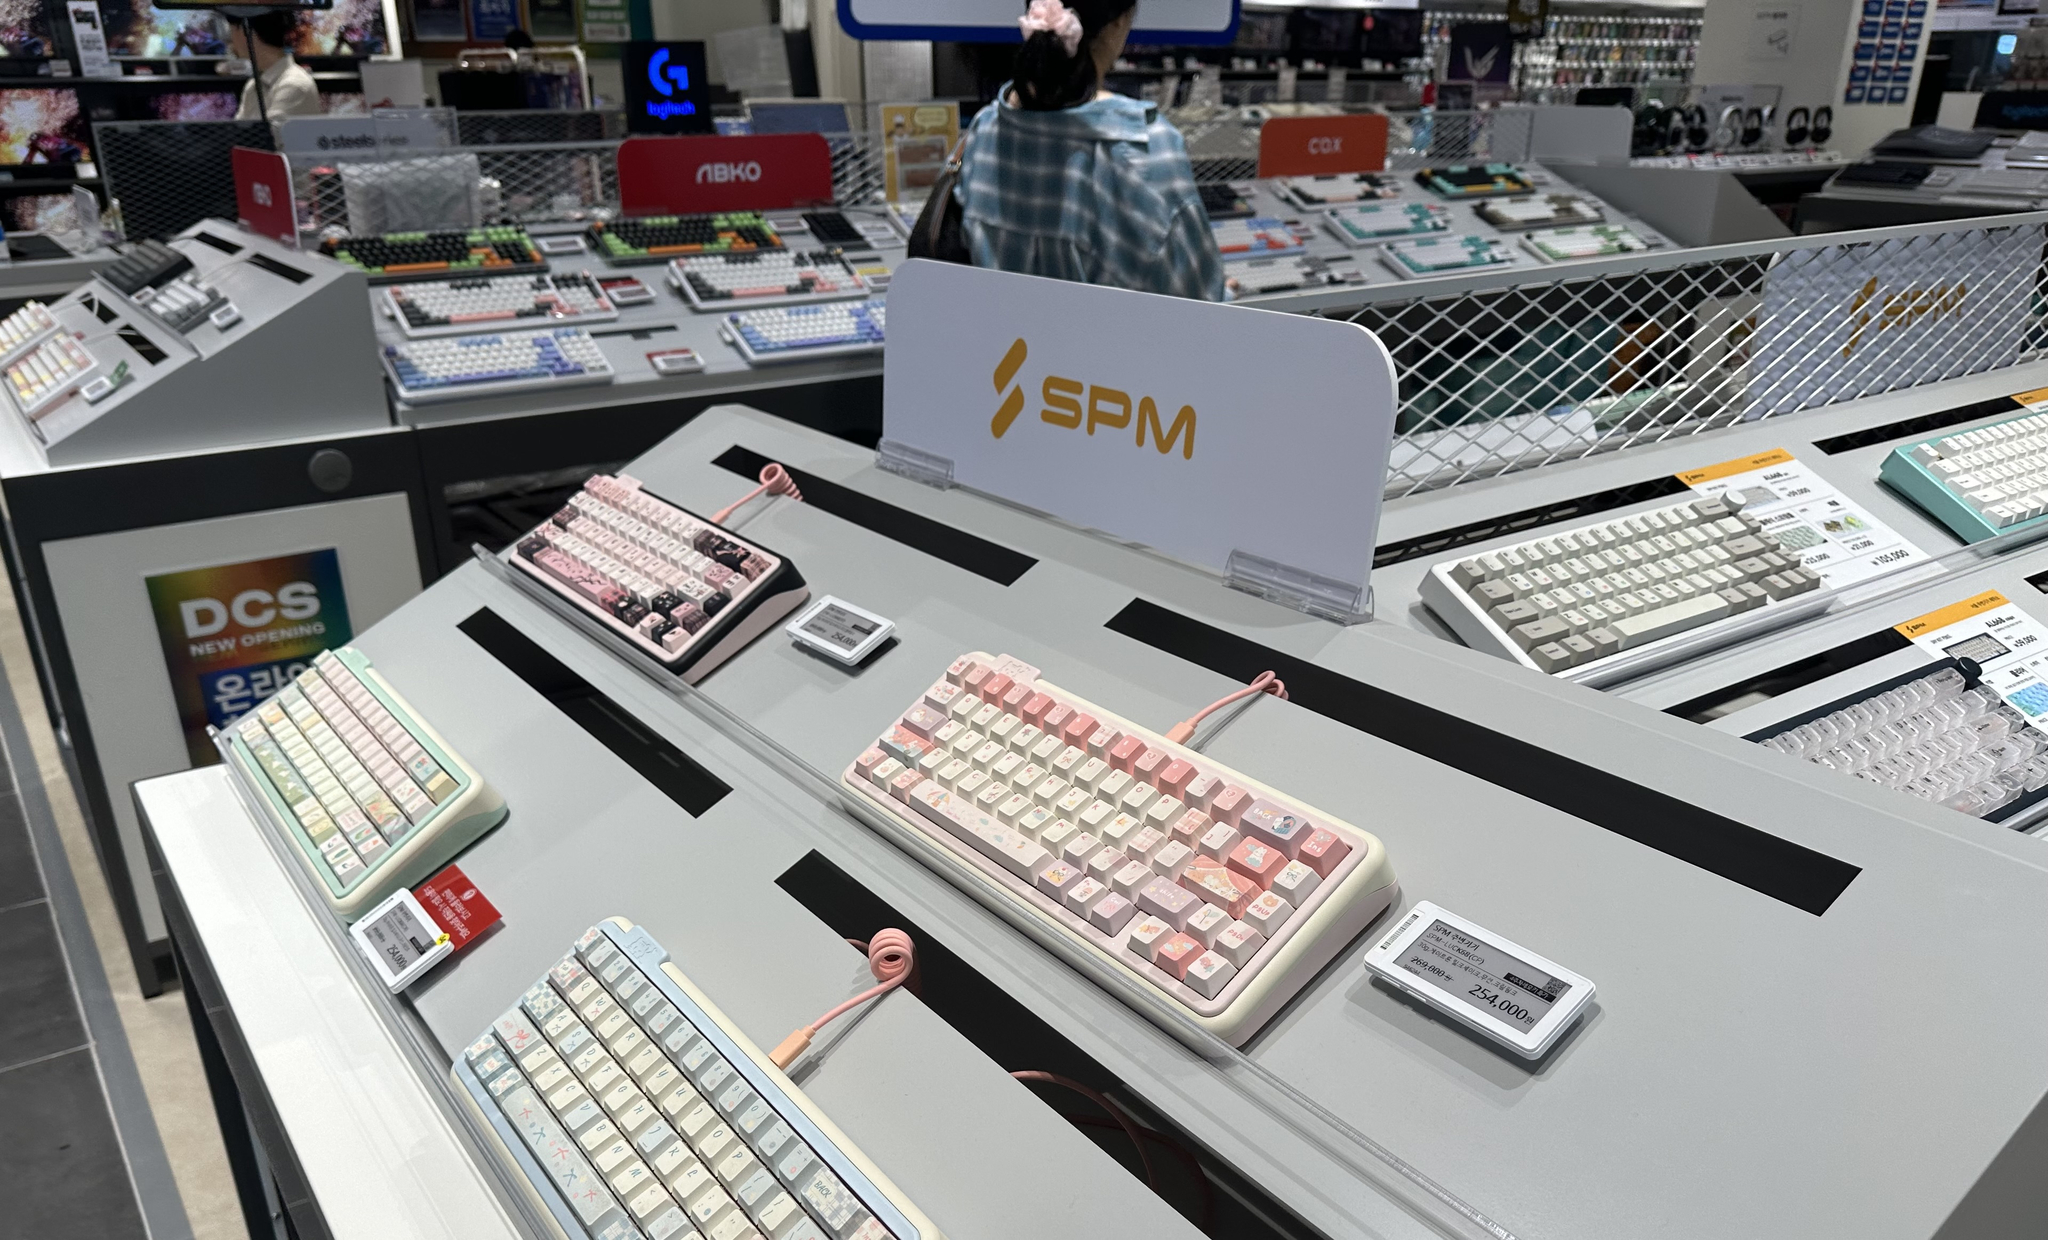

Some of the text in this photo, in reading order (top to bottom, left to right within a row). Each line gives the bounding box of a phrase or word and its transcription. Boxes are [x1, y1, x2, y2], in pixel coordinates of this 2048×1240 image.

[646, 99, 696, 121] logitech
[330, 133, 409, 148] steelsries
[1307, 136, 1343, 155] COX
[695, 161, 762, 184] ABKO
[1040, 375, 1197, 460] SPM
[179, 580, 321, 640] DCS
[188, 621, 326, 658] NEW OPENING
[213, 662, 308, 714] 온라
[1433, 925, 1451, 937] SPM
